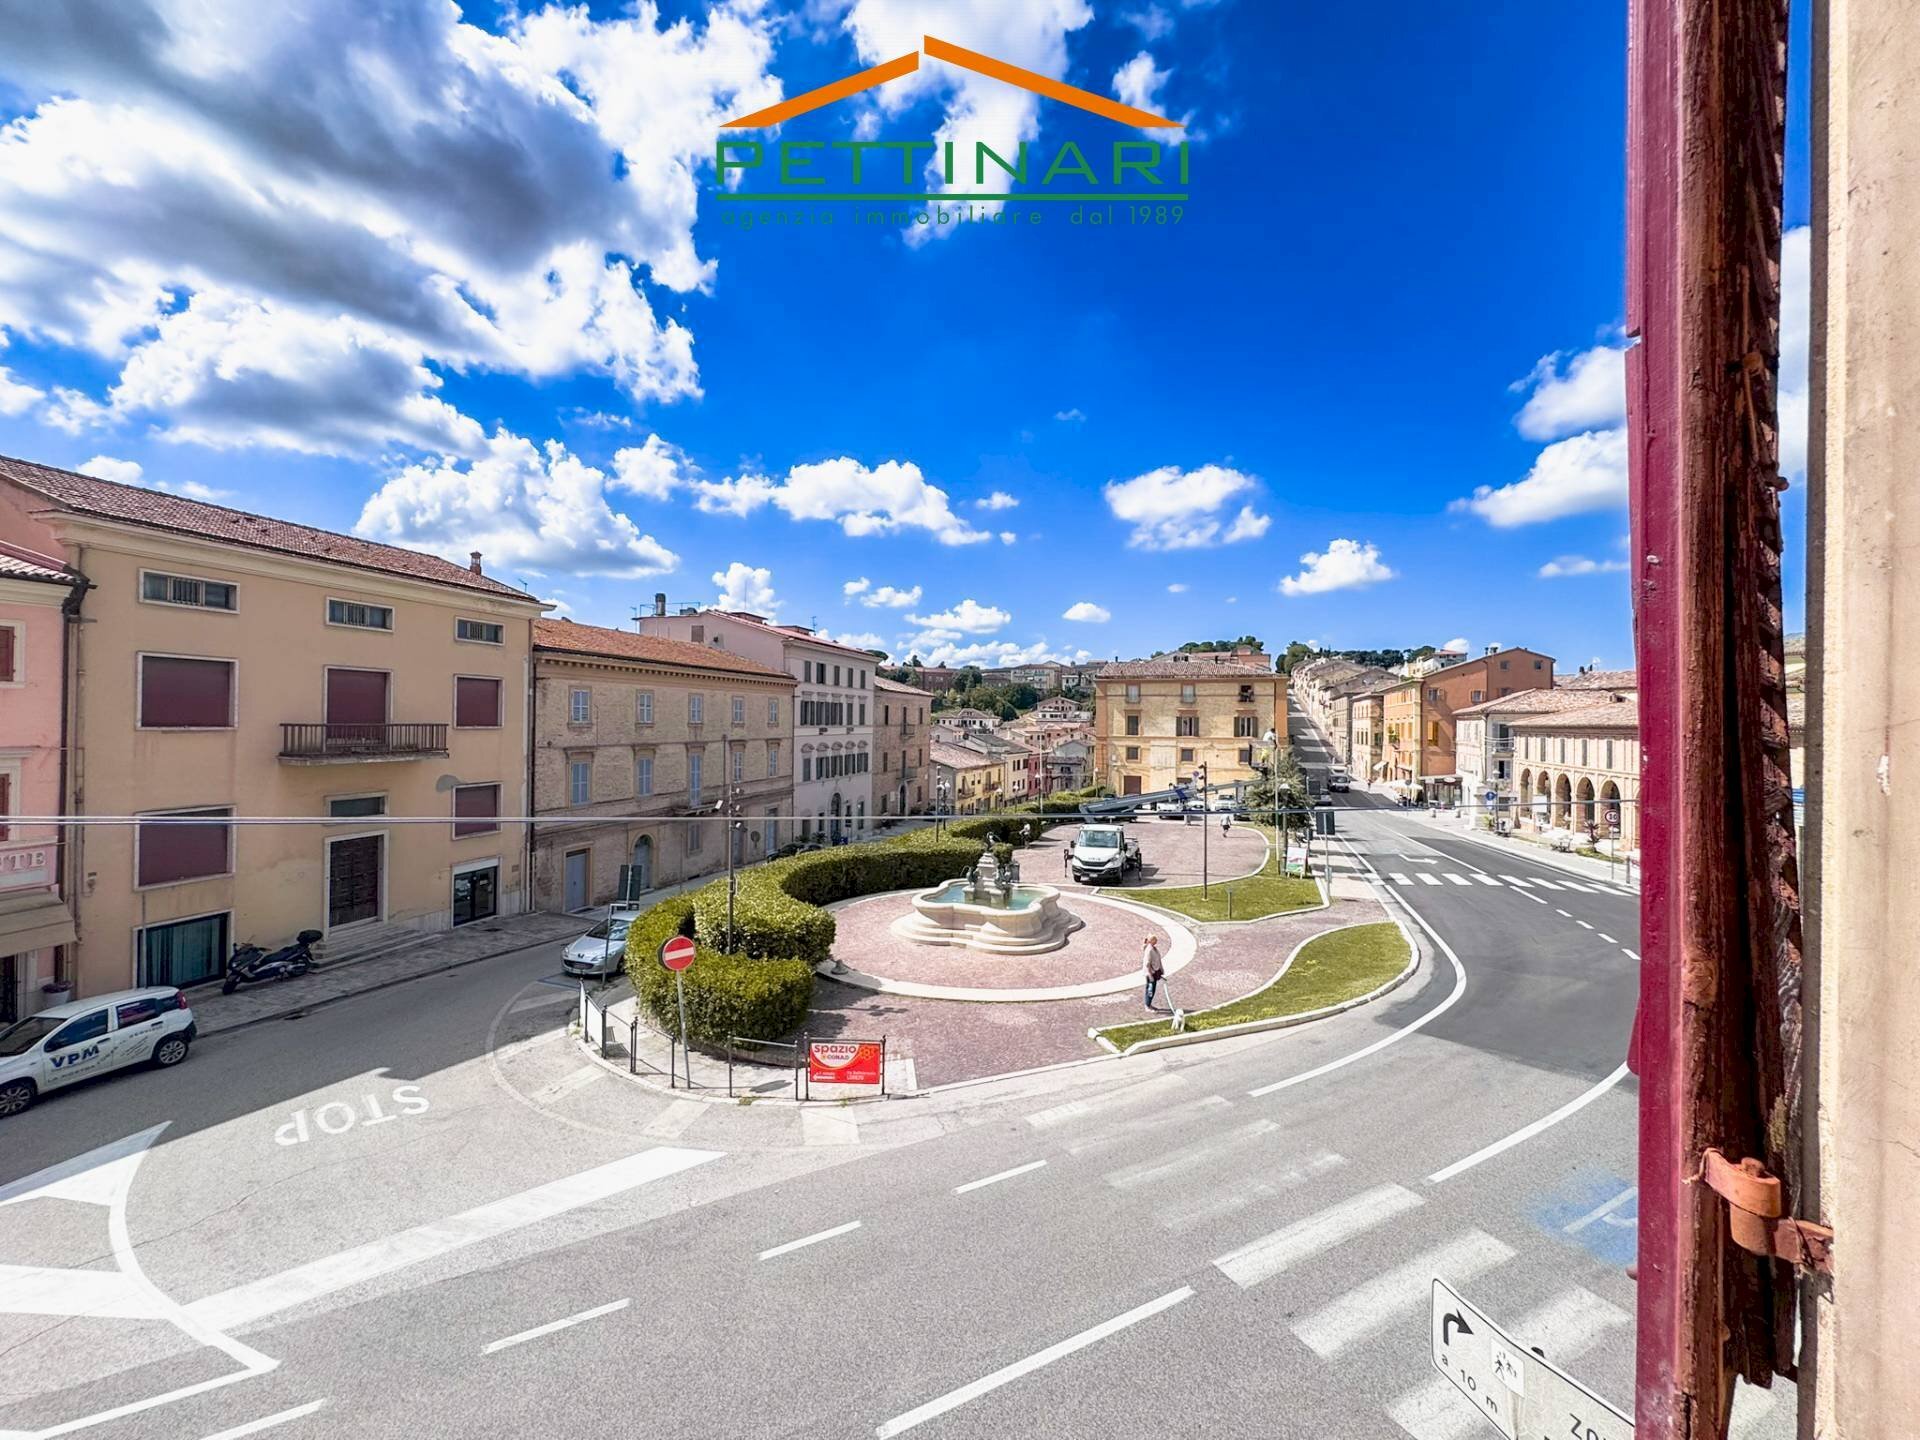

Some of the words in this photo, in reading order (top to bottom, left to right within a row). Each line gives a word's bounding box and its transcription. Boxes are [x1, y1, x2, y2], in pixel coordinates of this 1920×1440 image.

[50, 1044, 100, 1068] VPM
[274, 1085, 430, 1146] STOP
[1442, 1354, 1449, 1366] a
[1460, 1369, 1477, 1391] 10
[1486, 1396, 1498, 1414] m
